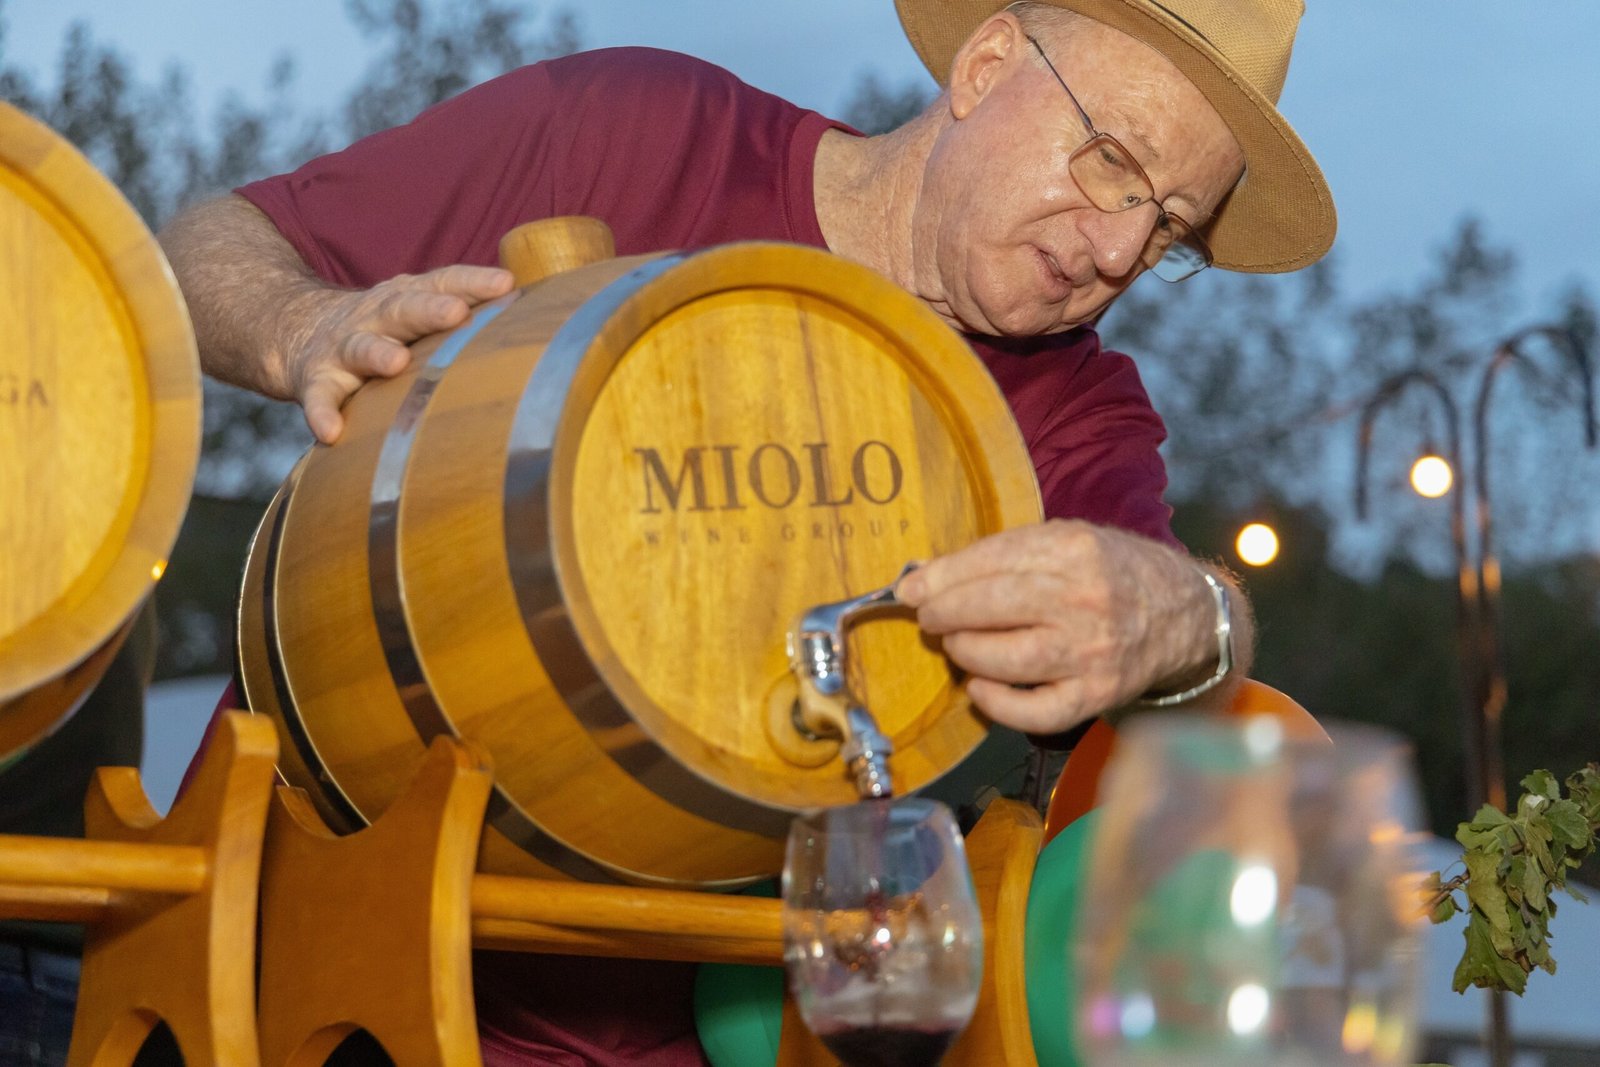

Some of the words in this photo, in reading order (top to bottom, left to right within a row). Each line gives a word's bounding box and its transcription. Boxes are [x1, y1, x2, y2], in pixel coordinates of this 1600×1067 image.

[634, 440, 903, 514] MIOLO
[644, 527, 752, 545] WINE
[780, 519, 910, 540] GROUP
